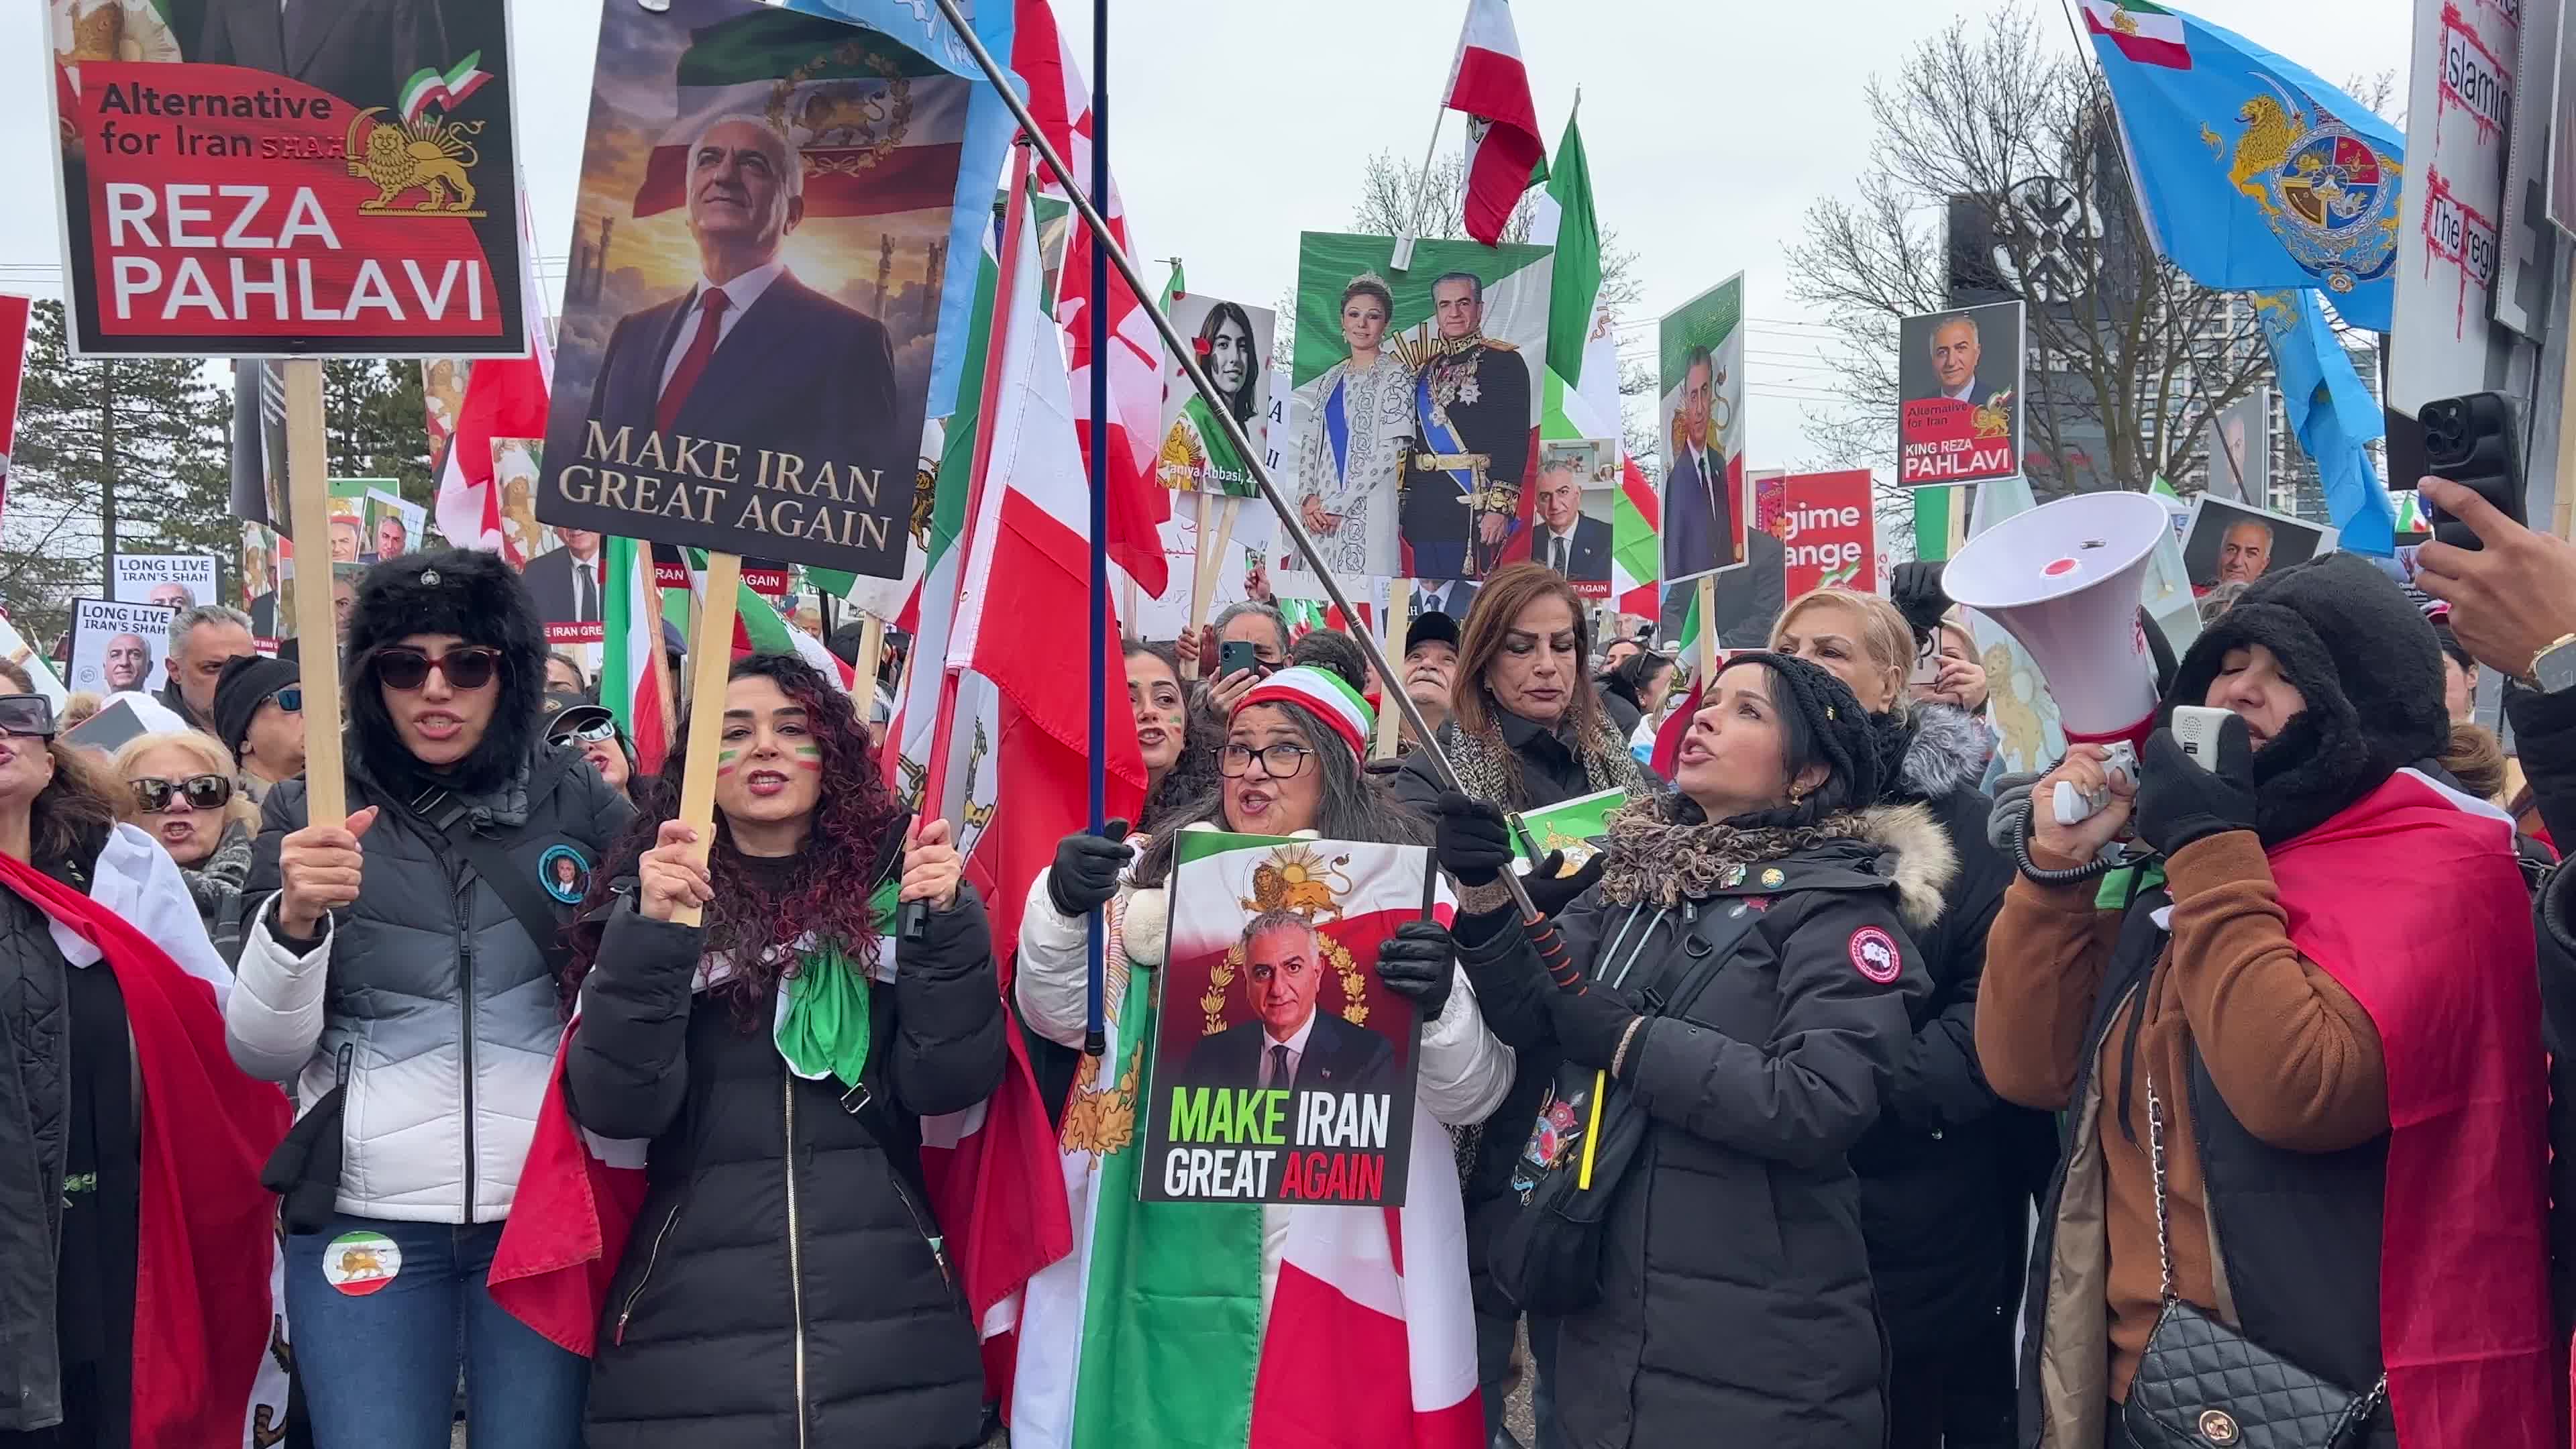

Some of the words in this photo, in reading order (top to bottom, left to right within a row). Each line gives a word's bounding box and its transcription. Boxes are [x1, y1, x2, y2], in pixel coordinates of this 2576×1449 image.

[99, 83, 333, 121] Alternative
[101, 121, 160, 156] for
[177, 122, 252, 157] Iran
[262, 136, 346, 159] SHAH
[105, 182, 341, 249] REZA
[2432, 195, 2460, 250] The
[2465, 229, 2496, 279] regi
[113, 256, 482, 321] PAHLAVI
[1907, 403, 1968, 417] Alternative
[1907, 417, 1922, 429] for
[1927, 415, 1948, 426] Iran
[1905, 442, 1937, 457] KING
[1941, 438, 1974, 453] REZA
[1905, 447, 2008, 478] PAHLAVI
[582, 419, 741, 483] MAKE
[753, 449, 884, 508] IRAN
[1203, 465, 1244, 484] Abbasi,
[1246, 471, 1258, 484] 2
[558, 464, 727, 525] GREAT
[733, 494, 892, 553] AGAIN
[1784, 502, 1860, 540] gime
[119, 559, 166, 571] LONG
[172, 560, 210, 571] LIVE
[1786, 541, 1862, 572] ange
[123, 572, 168, 582] IRAN'S
[172, 573, 208, 582] SHAH
[655, 568, 684, 580] RAN
[739, 574, 780, 587] AGAIN
[83, 605, 128, 621] LONG
[133, 609, 169, 624] LIVE
[84, 619, 128, 632] IRAN'S
[132, 623, 166, 635] SHAH
[553, 627, 578, 637] IRAN
[580, 625, 604, 636] GRE
[1169, 1086, 1291, 1144] MAKE
[1295, 1090, 1391, 1148] IRAN
[1163, 1148, 1277, 1198] GREAT
[1279, 1152, 1385, 1201] AGAIN
